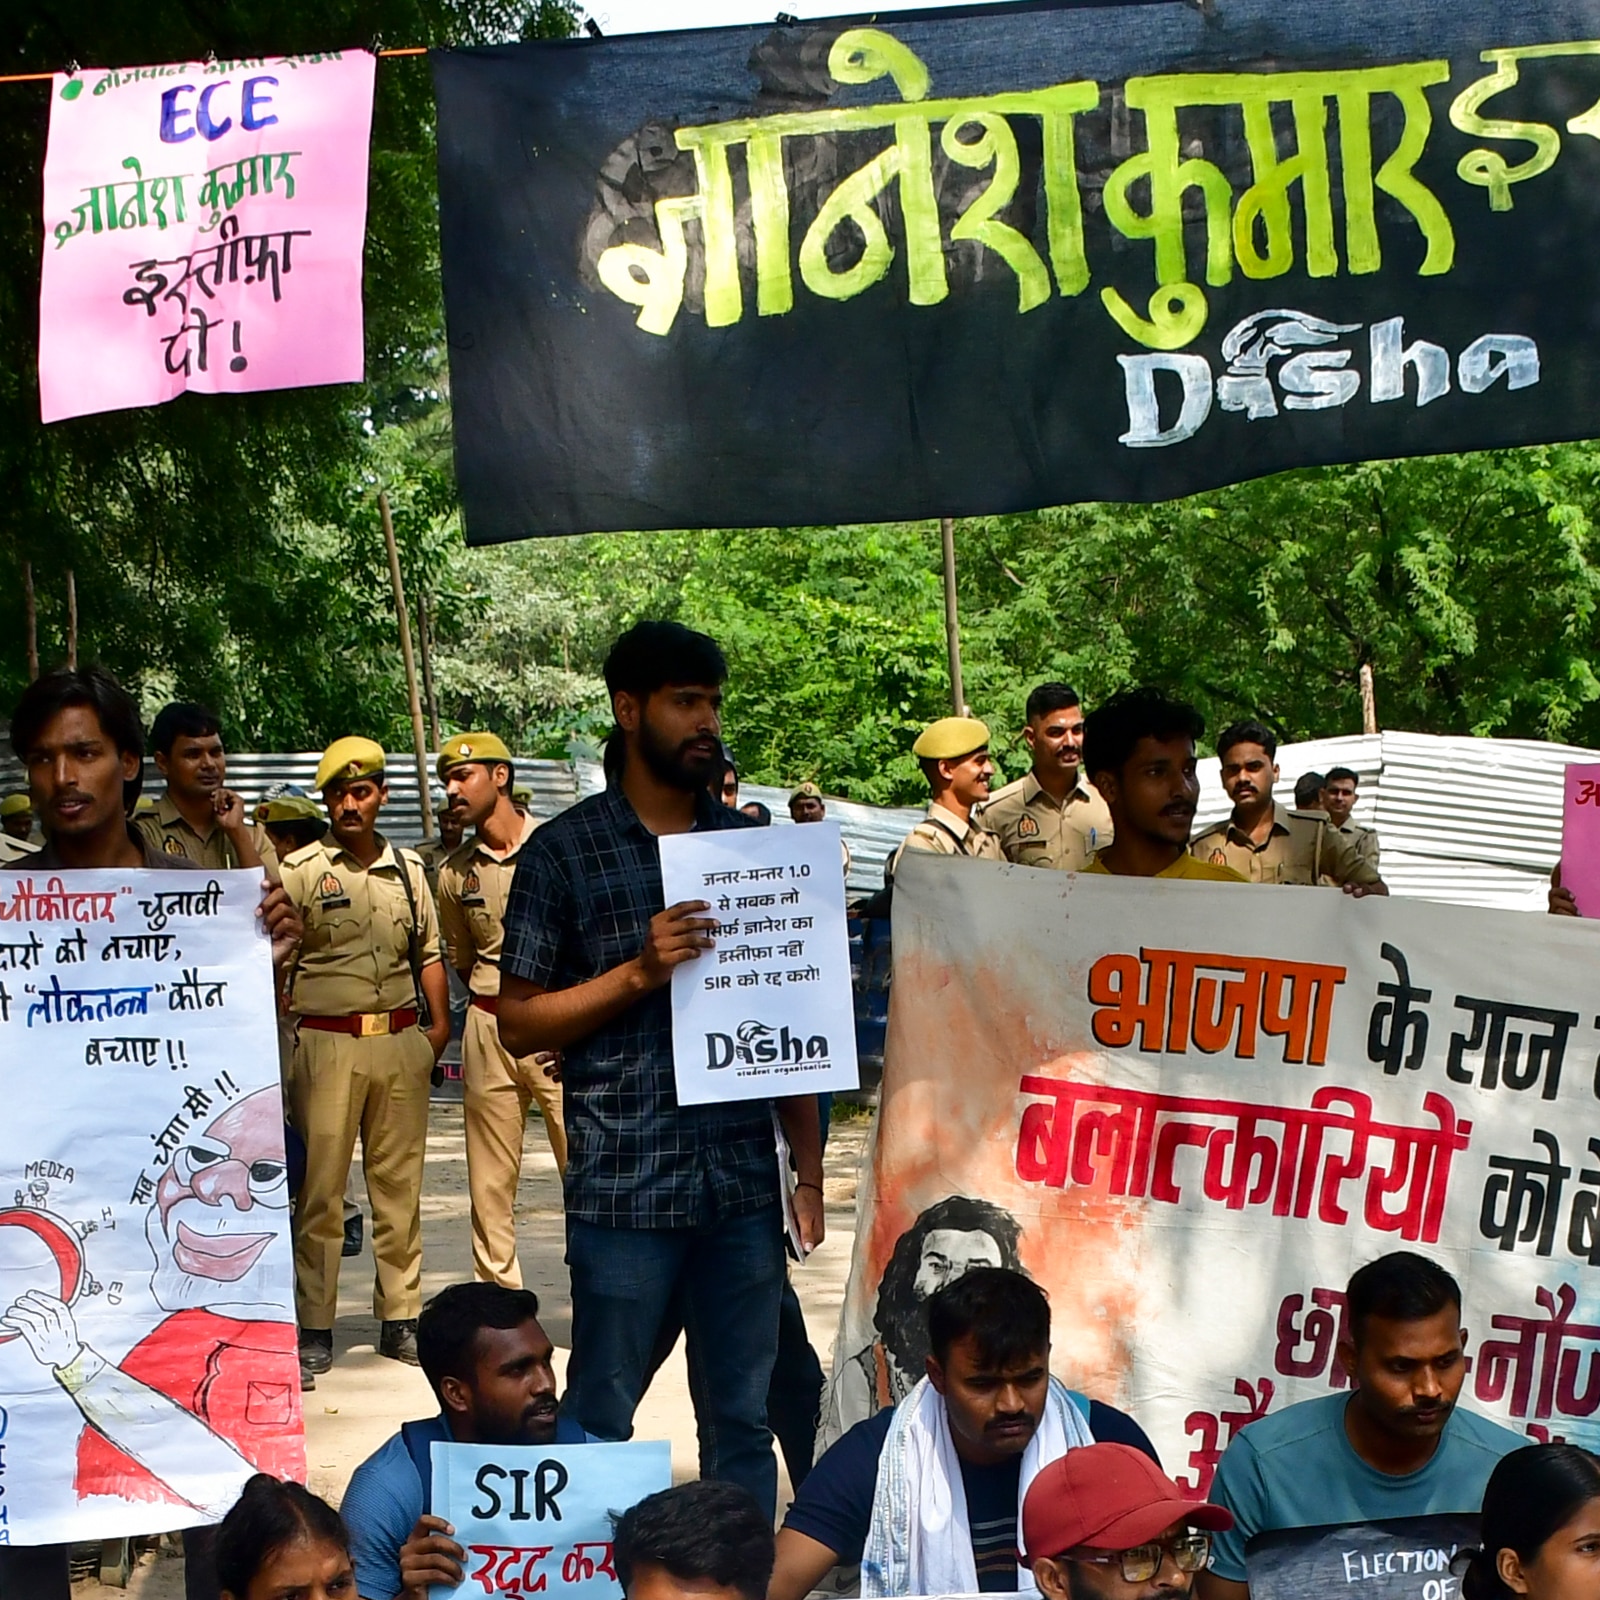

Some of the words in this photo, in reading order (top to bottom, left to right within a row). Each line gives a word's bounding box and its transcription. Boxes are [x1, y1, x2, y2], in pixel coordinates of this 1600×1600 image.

[160, 76, 278, 143] ECE
[199, 152, 302, 241] कुमार
[1101, 60, 1454, 361] कुमार
[1103, 293, 1540, 447] Disha
[702, 867, 784, 886] जन्तर-मन्तर
[717, 893, 731, 912] से
[780, 887, 799, 904] लो
[138, 880, 224, 931] चुनावी
[743, 916, 786, 935] ज्ञानेश
[56, 930, 87, 963] को
[717, 945, 773, 964] इस्तीफ़ा
[169, 973, 227, 1010] कौन
[786, 965, 819, 982] करो!
[705, 1020, 829, 1070] Disha
[1088, 947, 1360, 1074] भाजपा
[1368, 942, 1432, 1075] के
[1447, 995, 1579, 1100] राज
[25, 1160, 74, 1183] MEDIA
[1016, 1075, 1472, 1243] बलात्कारियों
[1480, 1129, 1571, 1256] को
[472, 1459, 568, 1521] SIR
